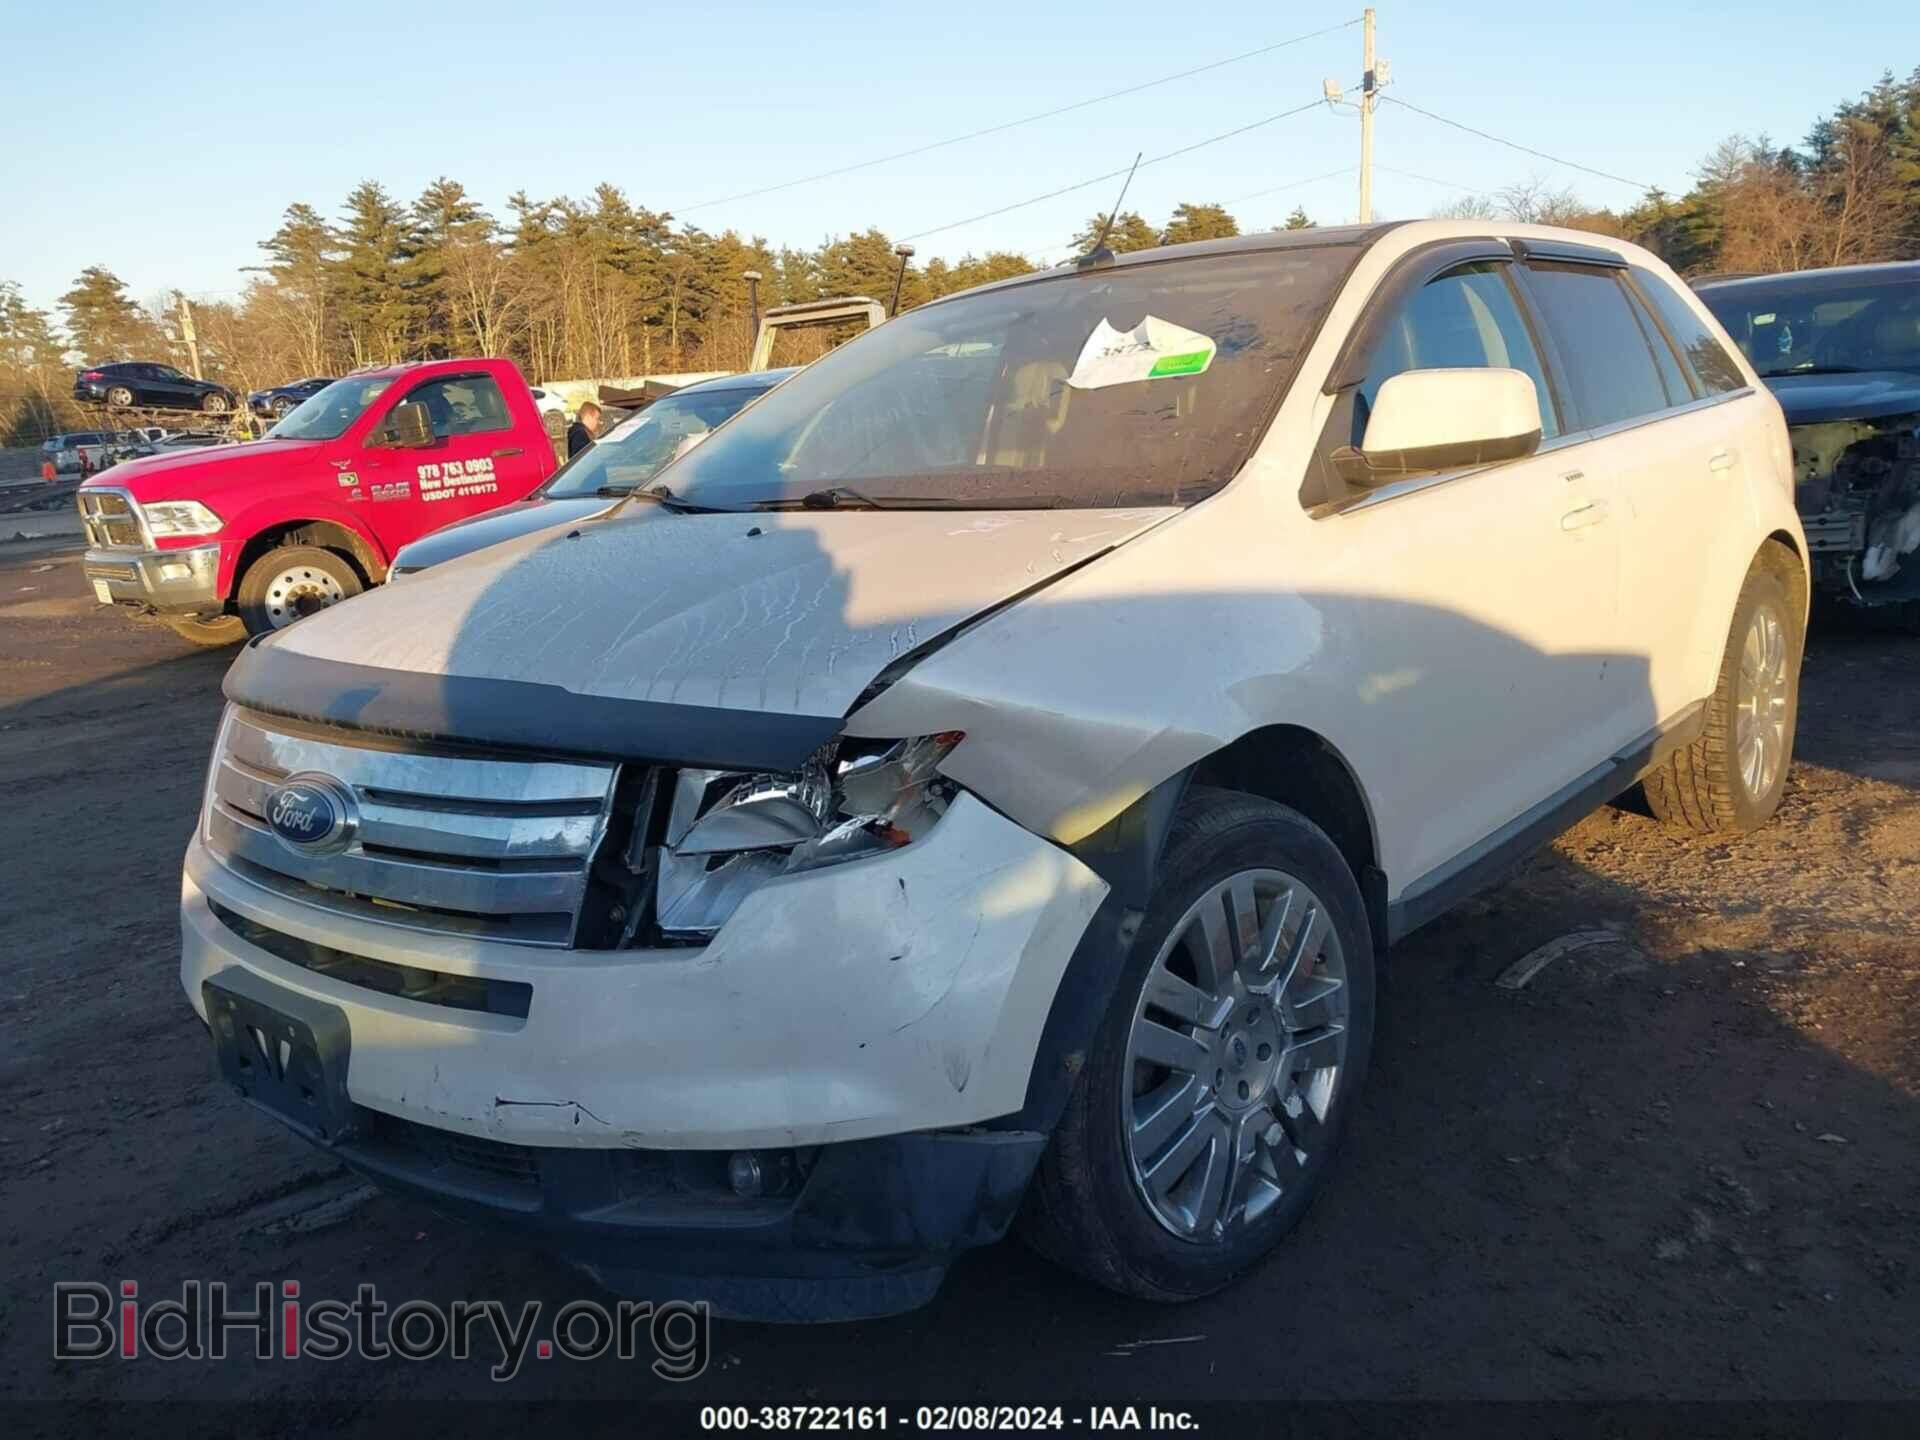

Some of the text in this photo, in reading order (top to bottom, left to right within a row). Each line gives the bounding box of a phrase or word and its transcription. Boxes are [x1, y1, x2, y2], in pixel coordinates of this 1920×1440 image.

[417, 457, 494, 479] 978 763 0903
[419, 473, 496, 490] New Destination
[422, 488, 456, 502] USDOT
[273, 791, 319, 832] Ford
